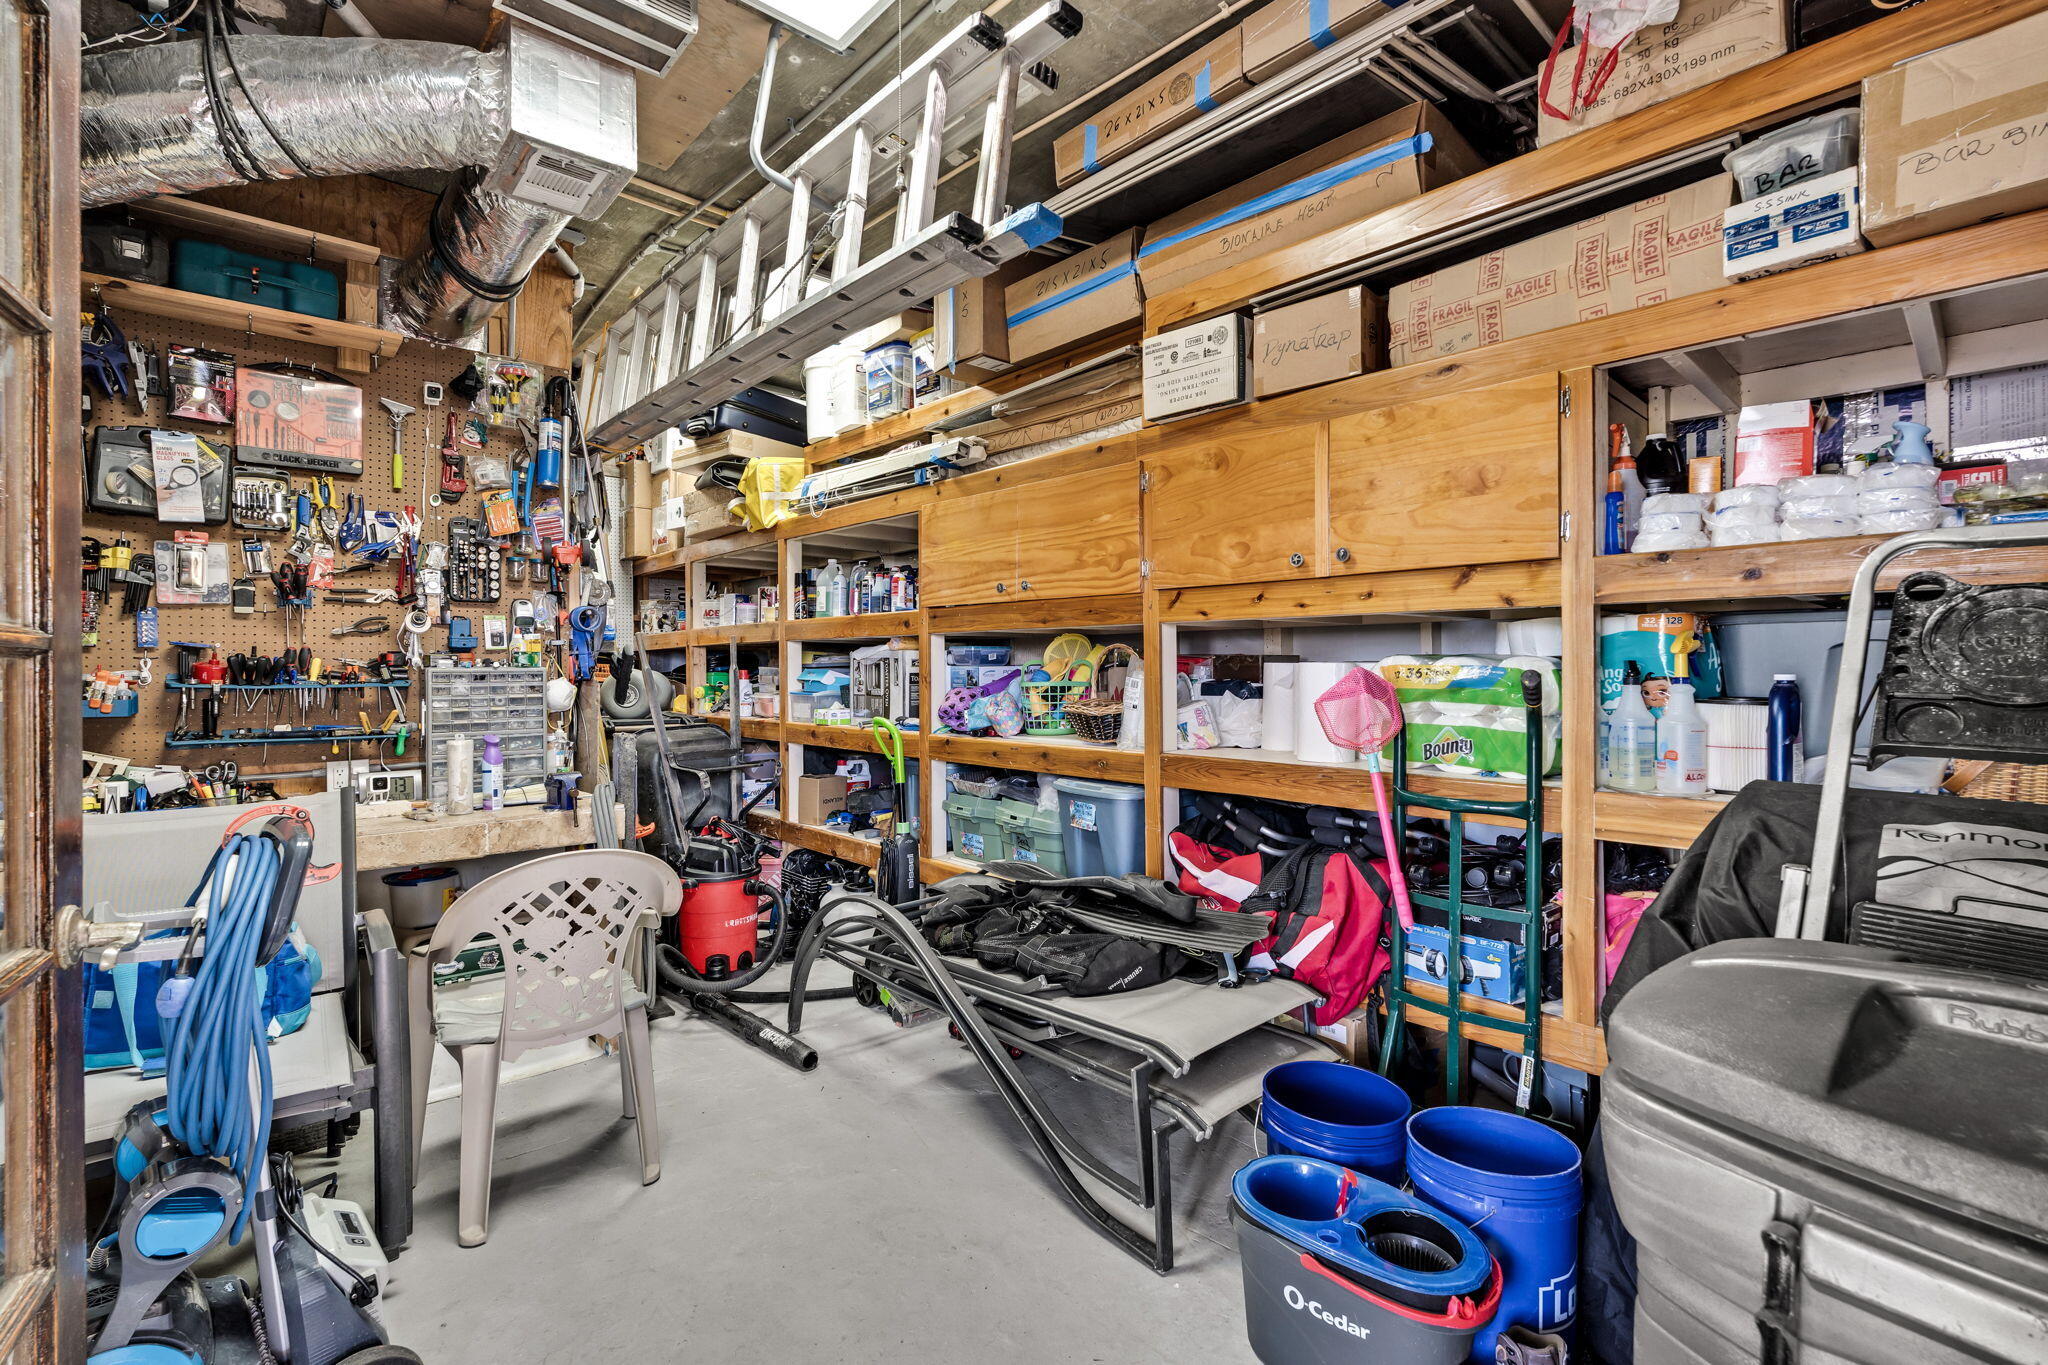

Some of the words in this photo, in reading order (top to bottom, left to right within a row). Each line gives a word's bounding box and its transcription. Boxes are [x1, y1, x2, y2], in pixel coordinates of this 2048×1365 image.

[1663, 21, 1679, 37] pc
[1663, 37, 1680, 50] kg
[1663, 52, 1680, 65] kg
[1613, 55, 1707, 100] 682X430X199
[1710, 45, 1736, 60] mm
[1104, 119, 1121, 139] 26
[1136, 103, 1146, 120] 21
[1159, 88, 1167, 105] 5
[1754, 155, 1819, 195] BAR
[1667, 217, 1724, 247] RAGILE
[1100, 248, 1110, 270] 5
[1643, 220, 1660, 276] FRAGILE
[1487, 250, 1501, 289] RAGILE
[1585, 238, 1600, 290] FRAGILE
[1505, 275, 1552, 299] RAGILE
[1416, 300, 1429, 347] FRAGILE
[1432, 300, 1474, 322] FRAGIL
[1486, 306, 1500, 344] FRAGI
[1041, 415, 1088, 440] MAT
[703, 609, 720, 617] ACE
[1666, 616, 1683, 625] 128
[1406, 667, 1423, 679] 36
[1423, 738, 1473, 762] Bounty
[907, 854, 915, 889] bissell
[1283, 1285, 1371, 1340] O-Cedar
